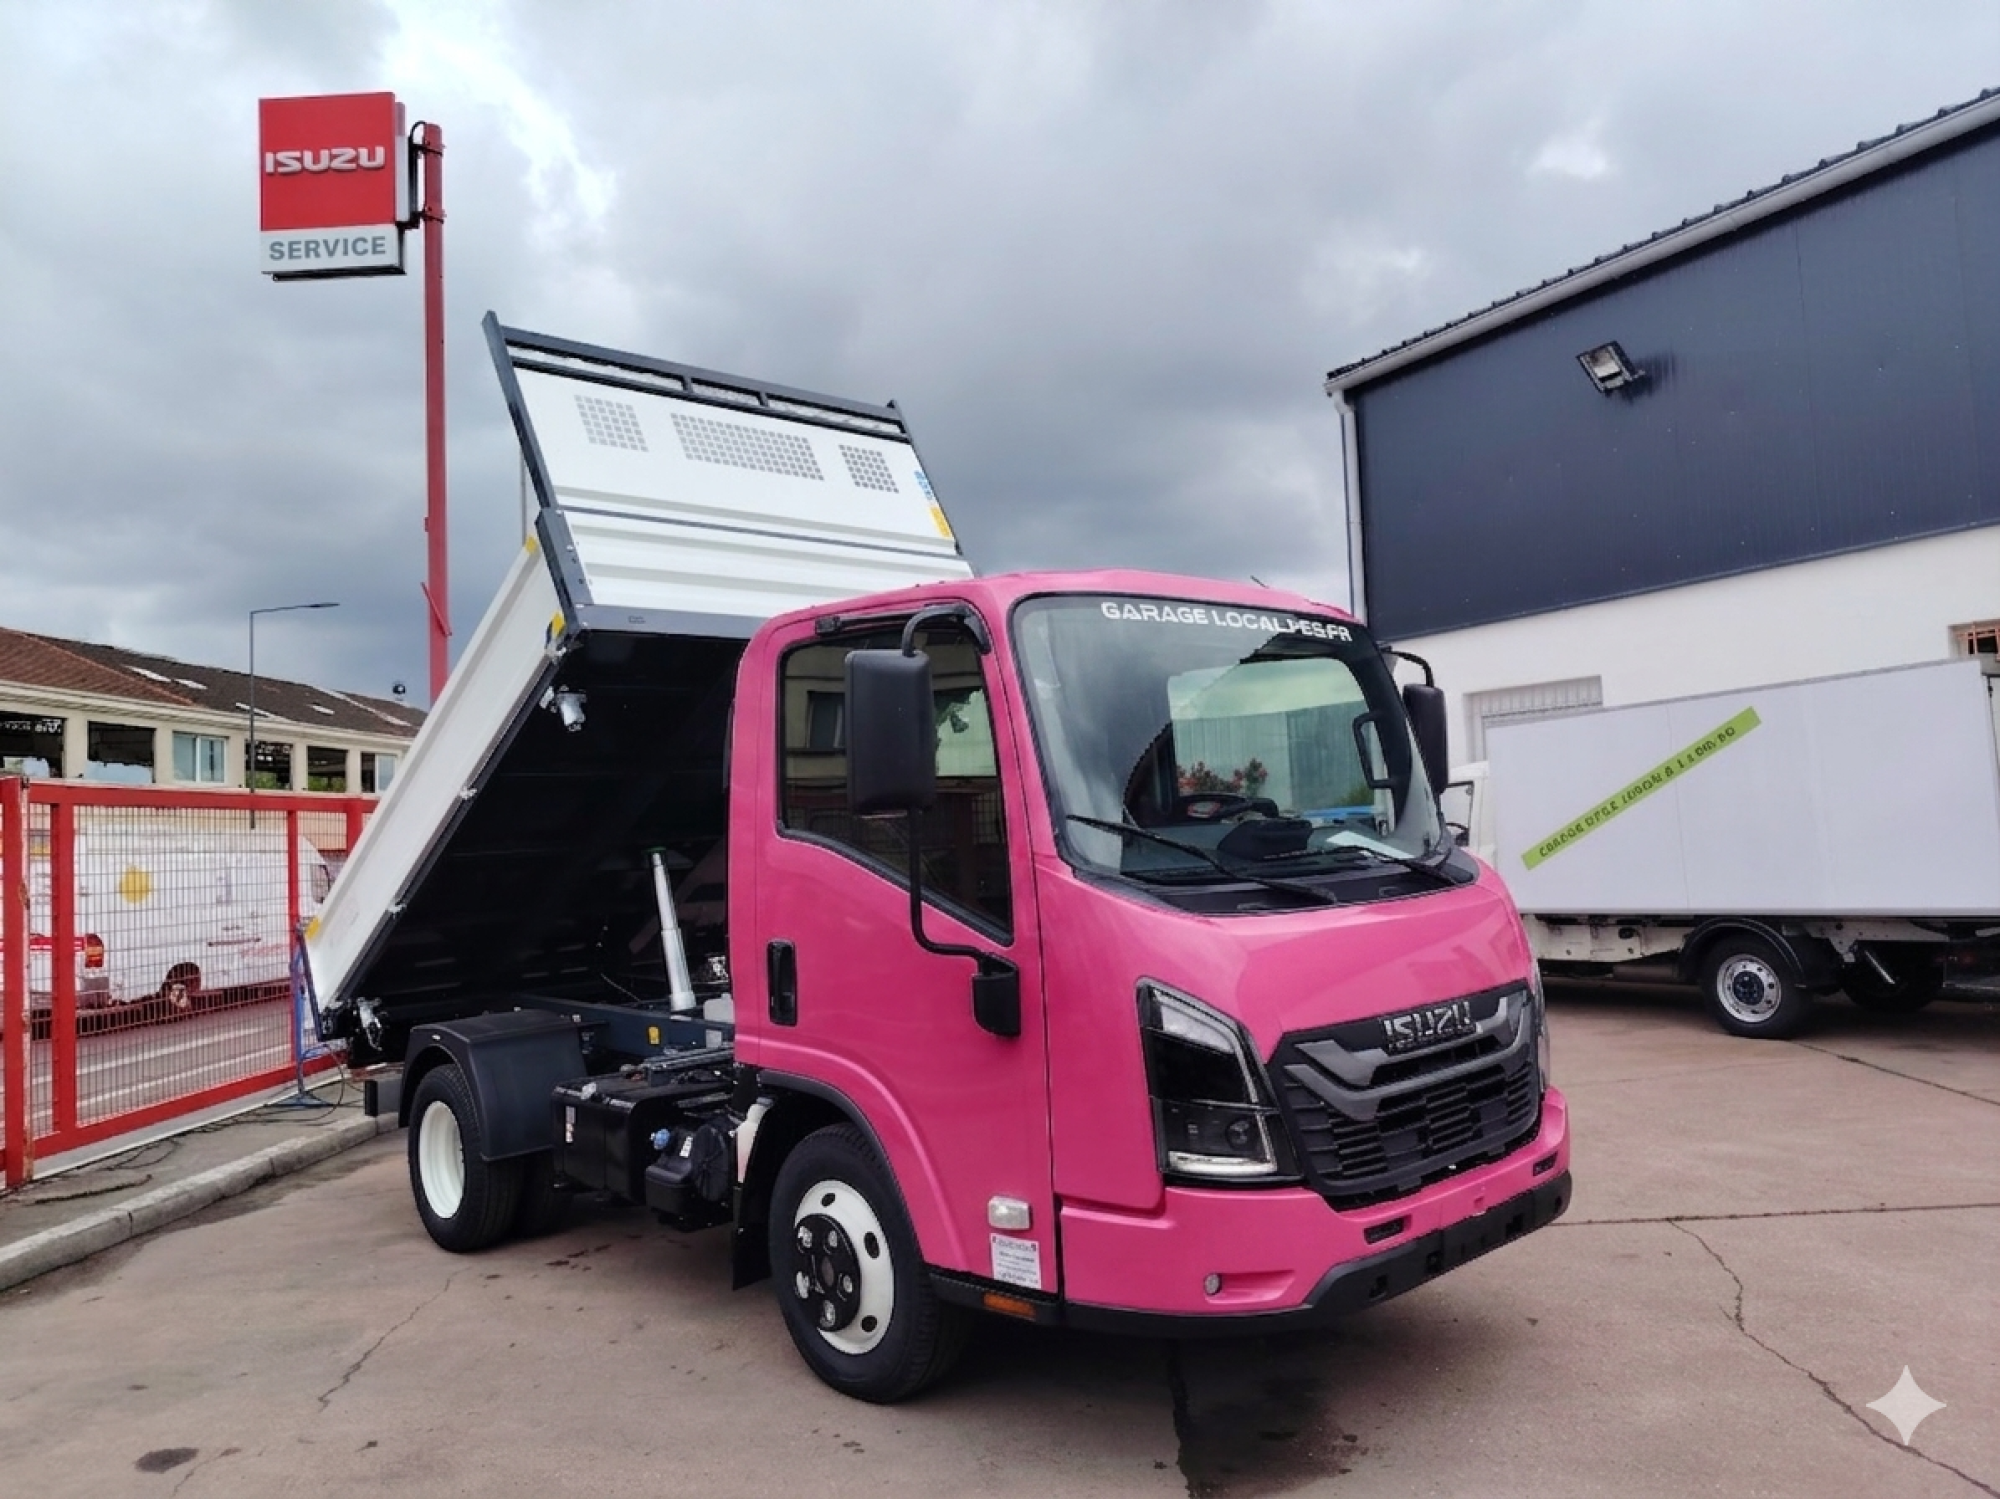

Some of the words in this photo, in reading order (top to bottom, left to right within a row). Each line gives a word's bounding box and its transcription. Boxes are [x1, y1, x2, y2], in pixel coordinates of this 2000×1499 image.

[265, 147, 385, 173] ISUZU
[269, 236, 386, 261] SERVICE
[1101, 602, 1208, 625] GARAGE
[1383, 1001, 1471, 1036] ISUZU
